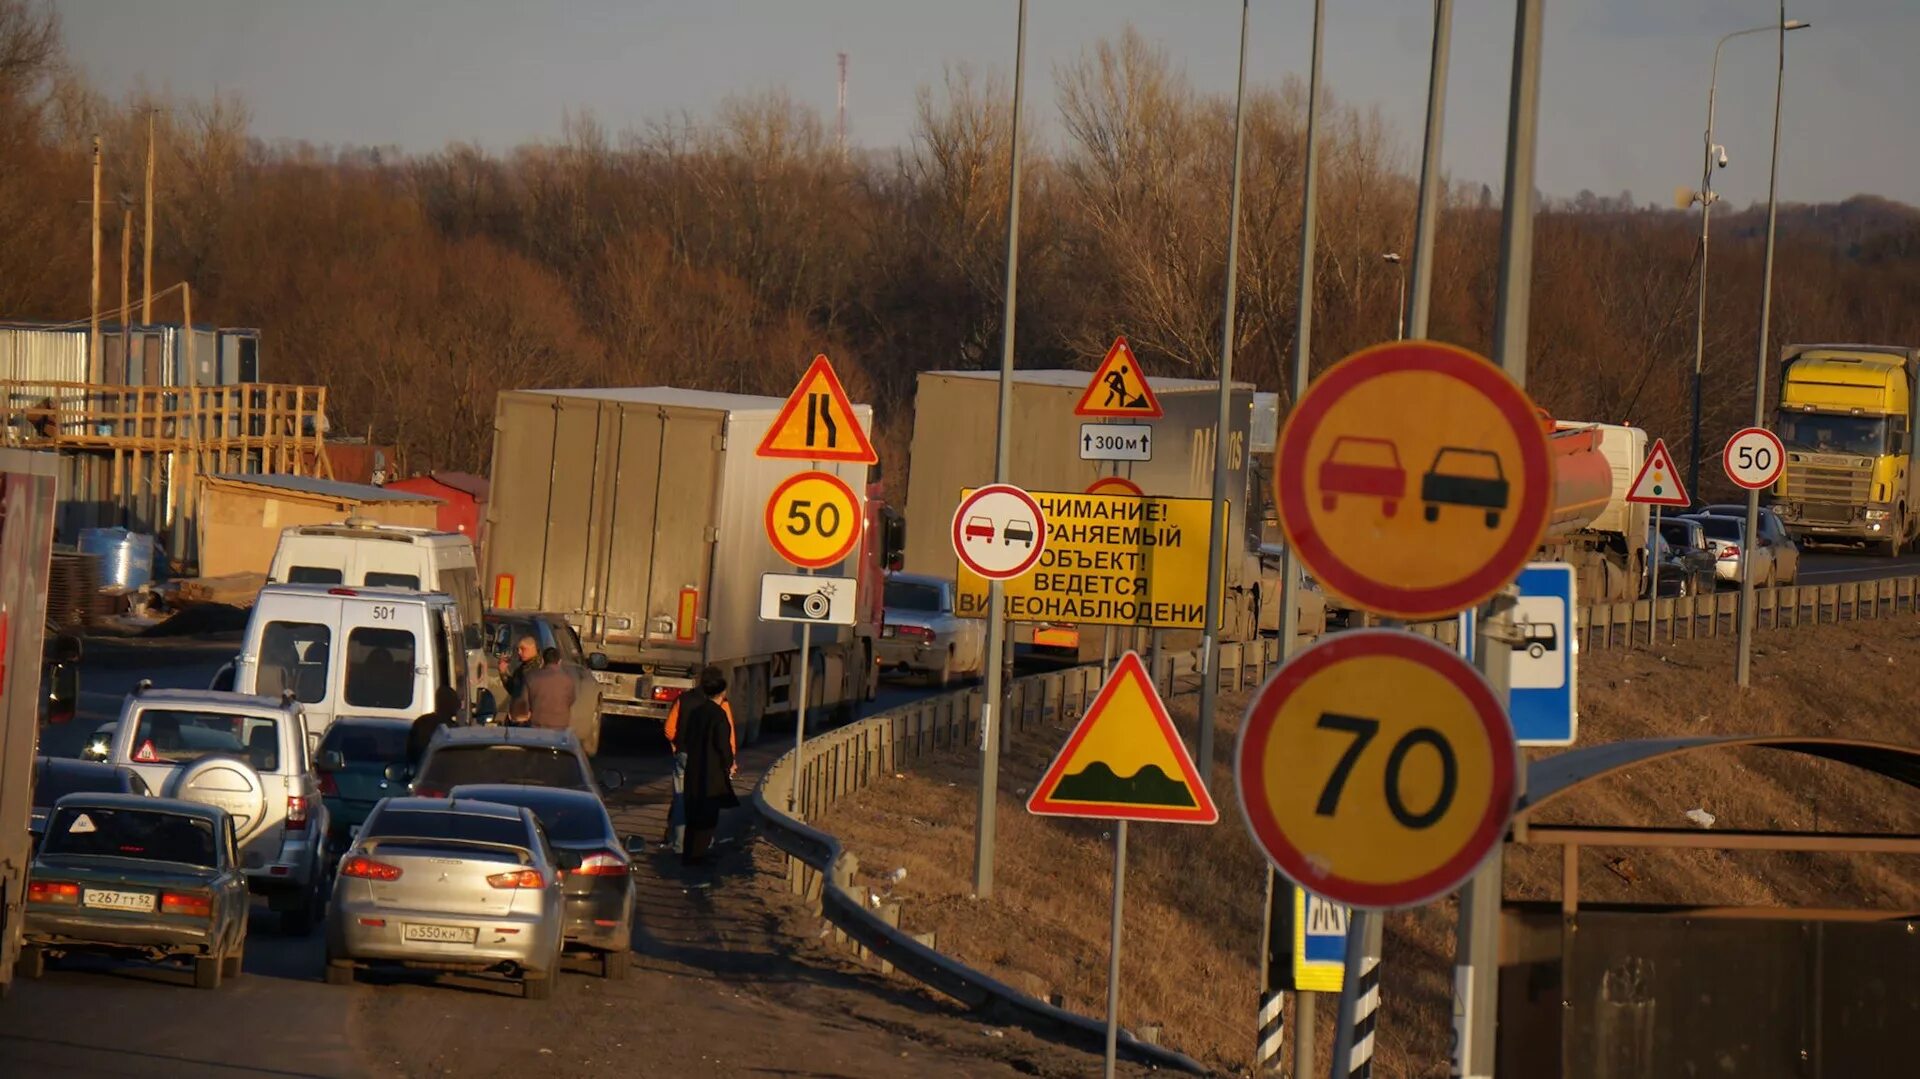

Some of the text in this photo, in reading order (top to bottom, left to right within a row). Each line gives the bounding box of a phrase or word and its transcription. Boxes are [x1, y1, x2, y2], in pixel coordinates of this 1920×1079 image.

[1739, 447, 1771, 470] 50
[787, 500, 839, 537] 50
[1040, 499, 1167, 521] НИМАНИЕ!
[1039, 549, 1145, 571] ОБЪЕКТ!
[1035, 573, 1147, 596] ВЕДЕТСЯ
[373, 606, 395, 620] 501
[1316, 712, 1458, 829] 70
